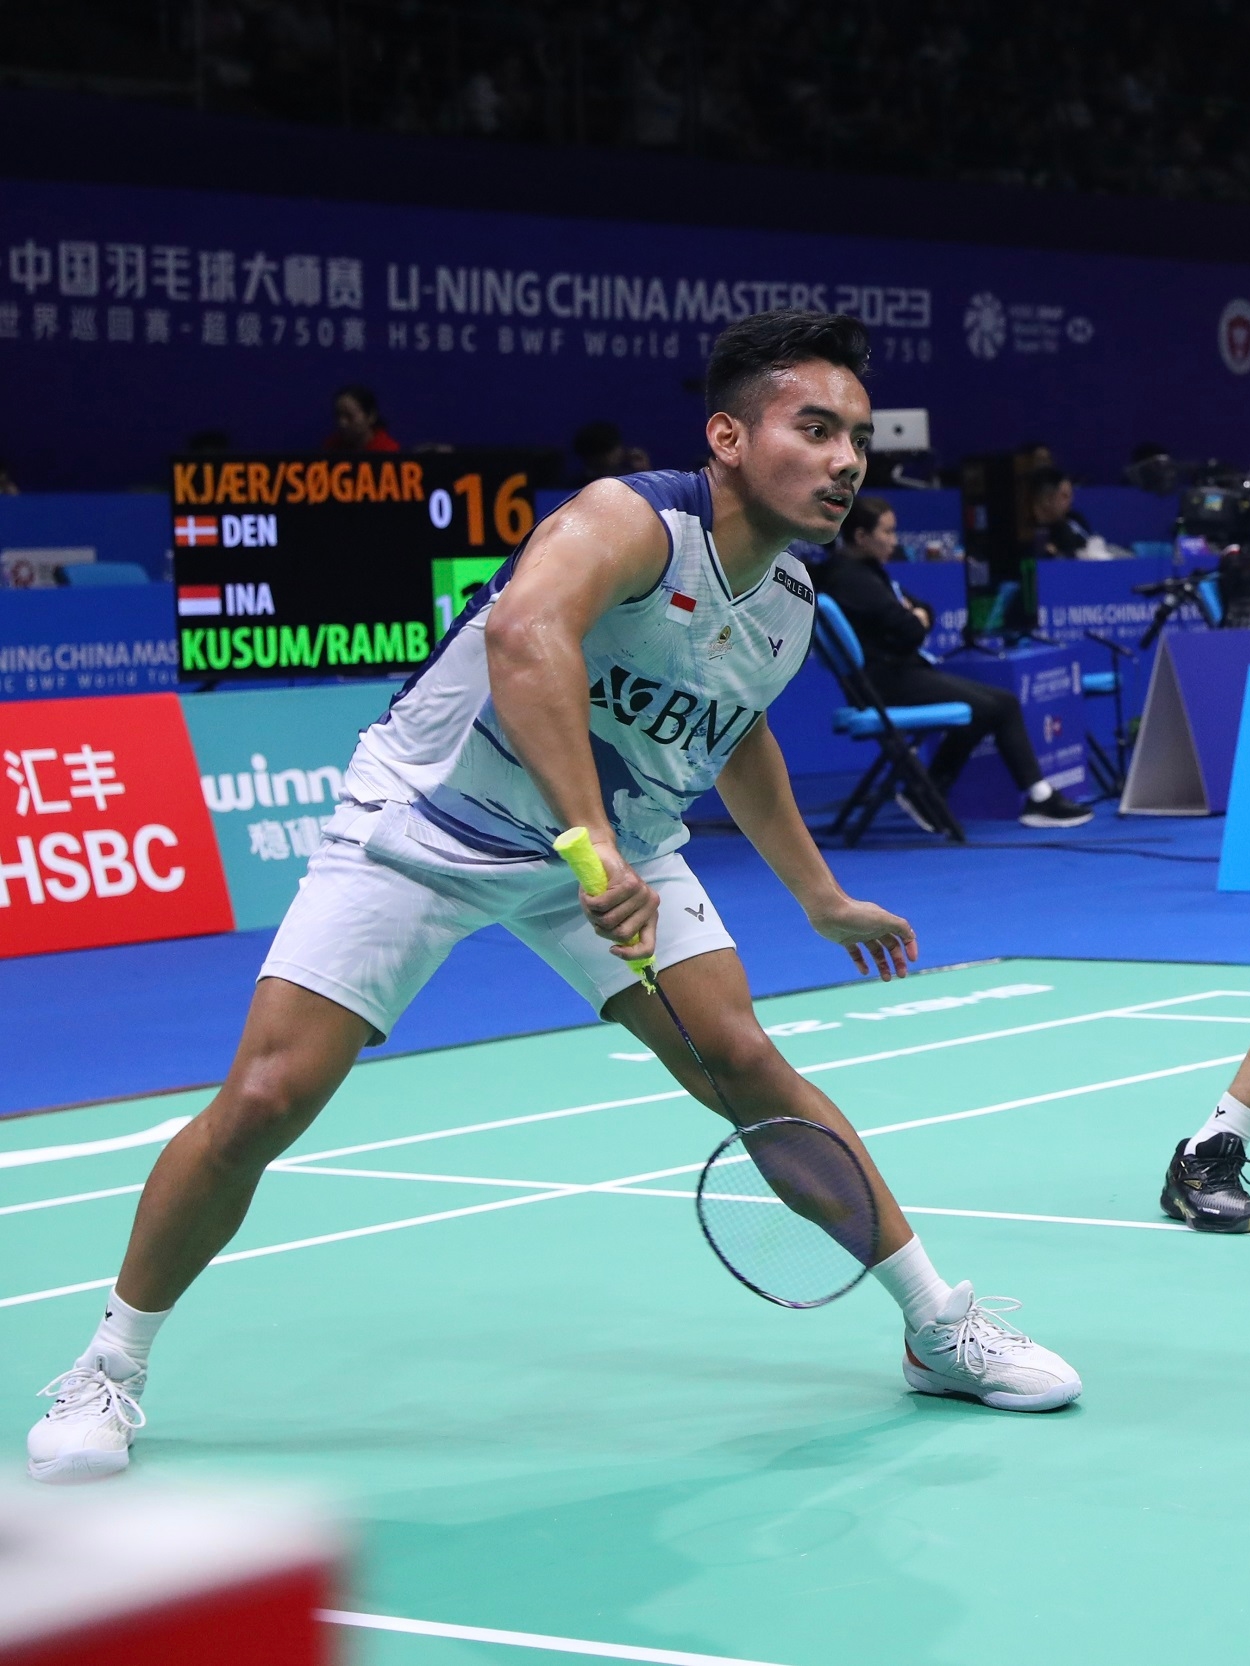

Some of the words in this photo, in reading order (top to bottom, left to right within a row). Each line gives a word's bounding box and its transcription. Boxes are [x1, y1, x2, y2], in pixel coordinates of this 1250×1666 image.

[387, 262, 541, 317] LI-NING
[546, 271, 670, 322] CHINA
[674, 277, 830, 324] MASTERS
[836, 285, 932, 329] 2023
[387, 321, 478, 352] HSBC
[498, 325, 565, 356] BWF
[583, 329, 680, 360] World
[174, 461, 424, 504] KJÆR/SØGAAR
[221, 514, 278, 548] DEN
[454, 473, 535, 547] 16
[226, 583, 275, 616] INA
[55, 642, 131, 671] CHINA
[182, 621, 430, 671] KUSUM/RAMB
[3, 743, 126, 817] 汇丰
[200, 752, 345, 813] winn
[0, 823, 186, 909] HSBC
